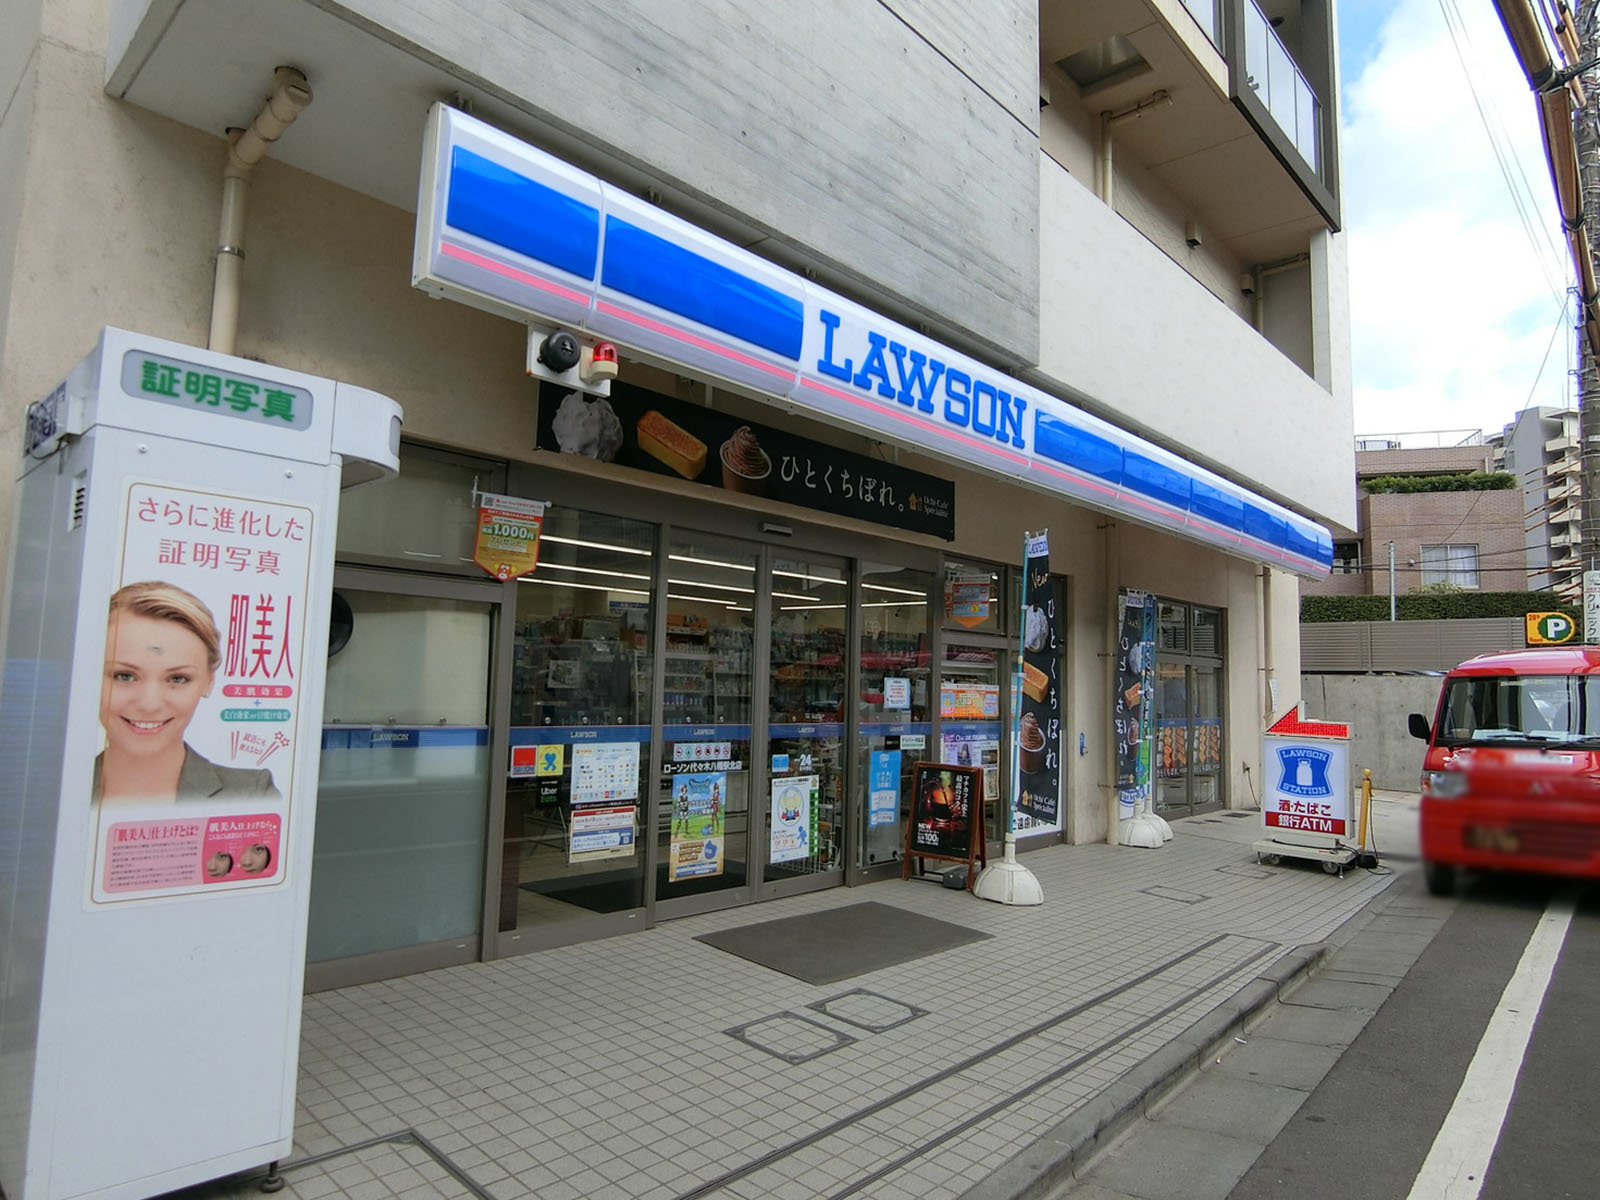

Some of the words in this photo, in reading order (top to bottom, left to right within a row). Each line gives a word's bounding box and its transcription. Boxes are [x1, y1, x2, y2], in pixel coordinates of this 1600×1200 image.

[817, 309, 1027, 449] LAWSON
[140, 360, 296, 422] 証明写真
[780, 453, 905, 513] ひとくちぼれ。
[138, 497, 305, 542] さらに進化した
[158, 537, 281, 575] 証明写真
[1587, 593, 1597, 636] クリニック
[224, 593, 294, 679] 肌美人
[1547, 618, 1567, 638] P
[1045, 598, 1059, 787] ひとくちぼれ。
[799, 753, 812, 766] 24
[1281, 749, 1328, 762] LAWSON
[663, 760, 743, 774] ローソン代々木八幡駅北店
[540, 787, 558, 795] Uber
[1281, 781, 1327, 795] STATION
[540, 795, 557, 803] Eats
[1278, 799, 1332, 817] 酒・たばこ
[1277, 814, 1333, 833] 銀行ATM
